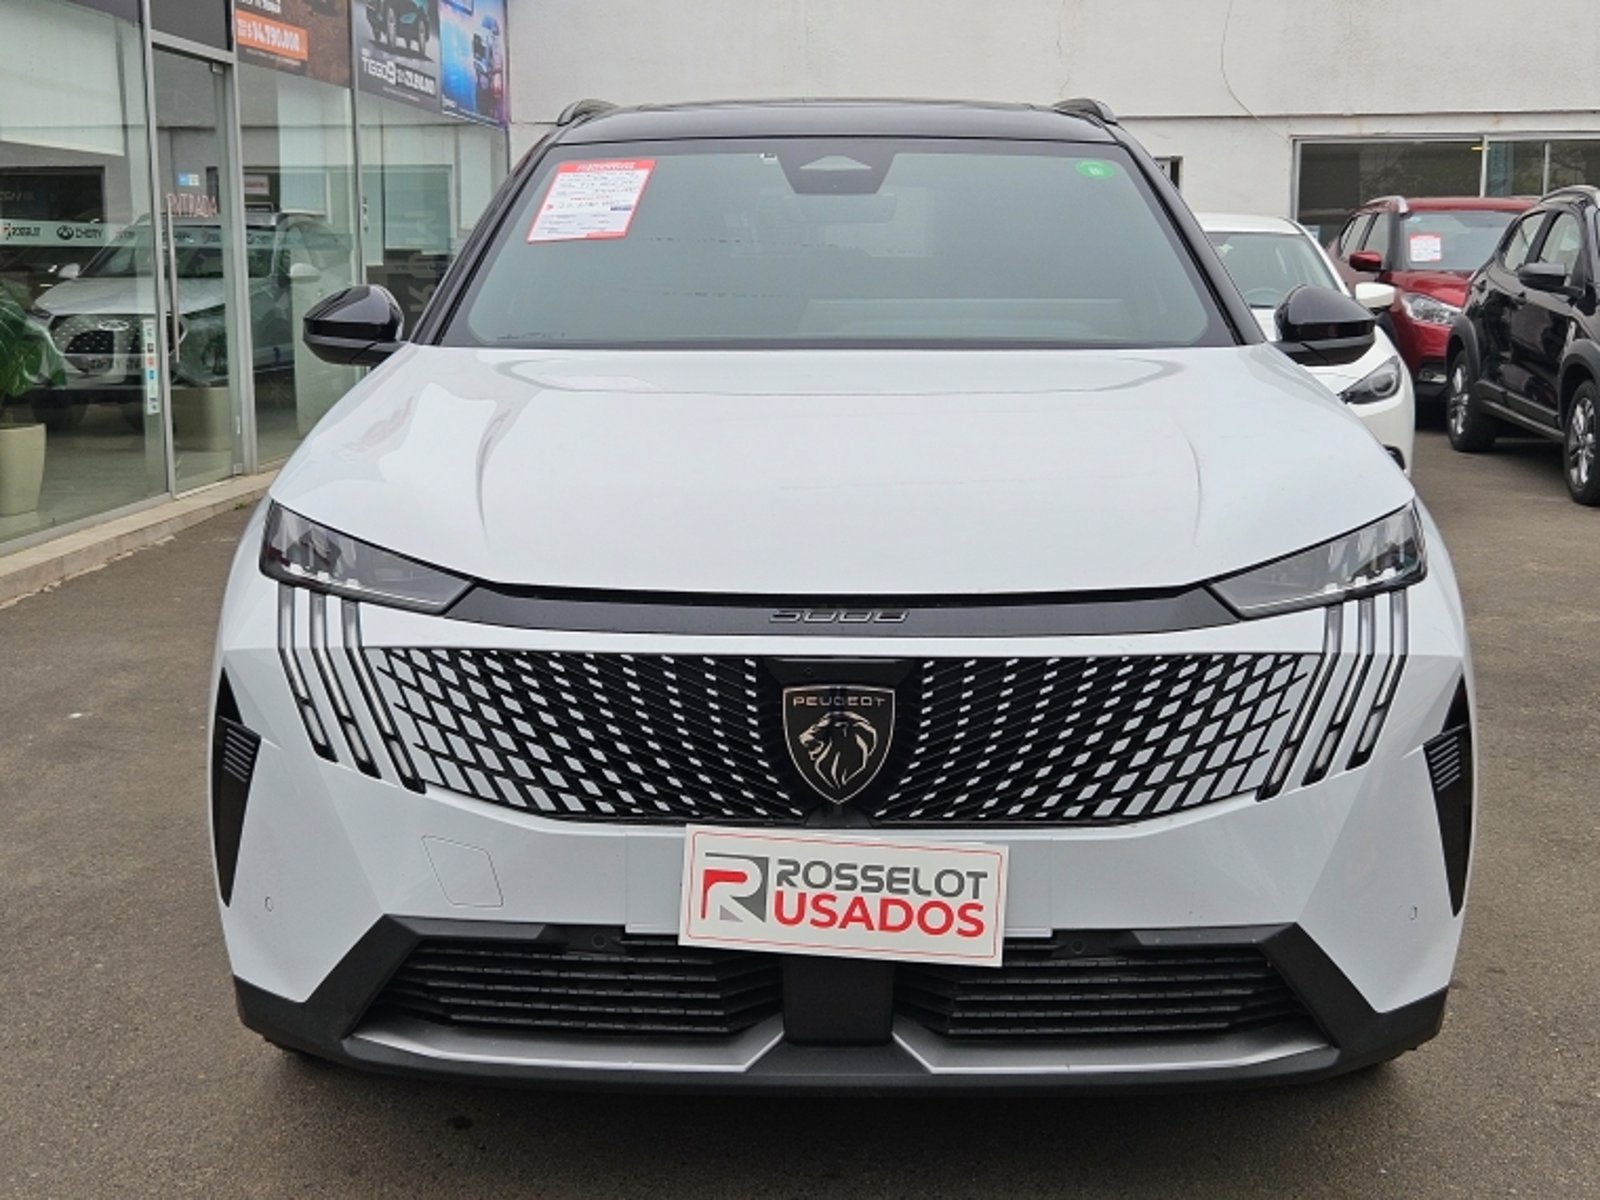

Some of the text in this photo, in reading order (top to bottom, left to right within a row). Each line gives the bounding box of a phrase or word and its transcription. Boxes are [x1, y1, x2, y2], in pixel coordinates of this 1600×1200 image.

[792, 695, 887, 708] PEUGEOT
[776, 858, 988, 899] ROSSELOT
[773, 889, 985, 938] USADOS
